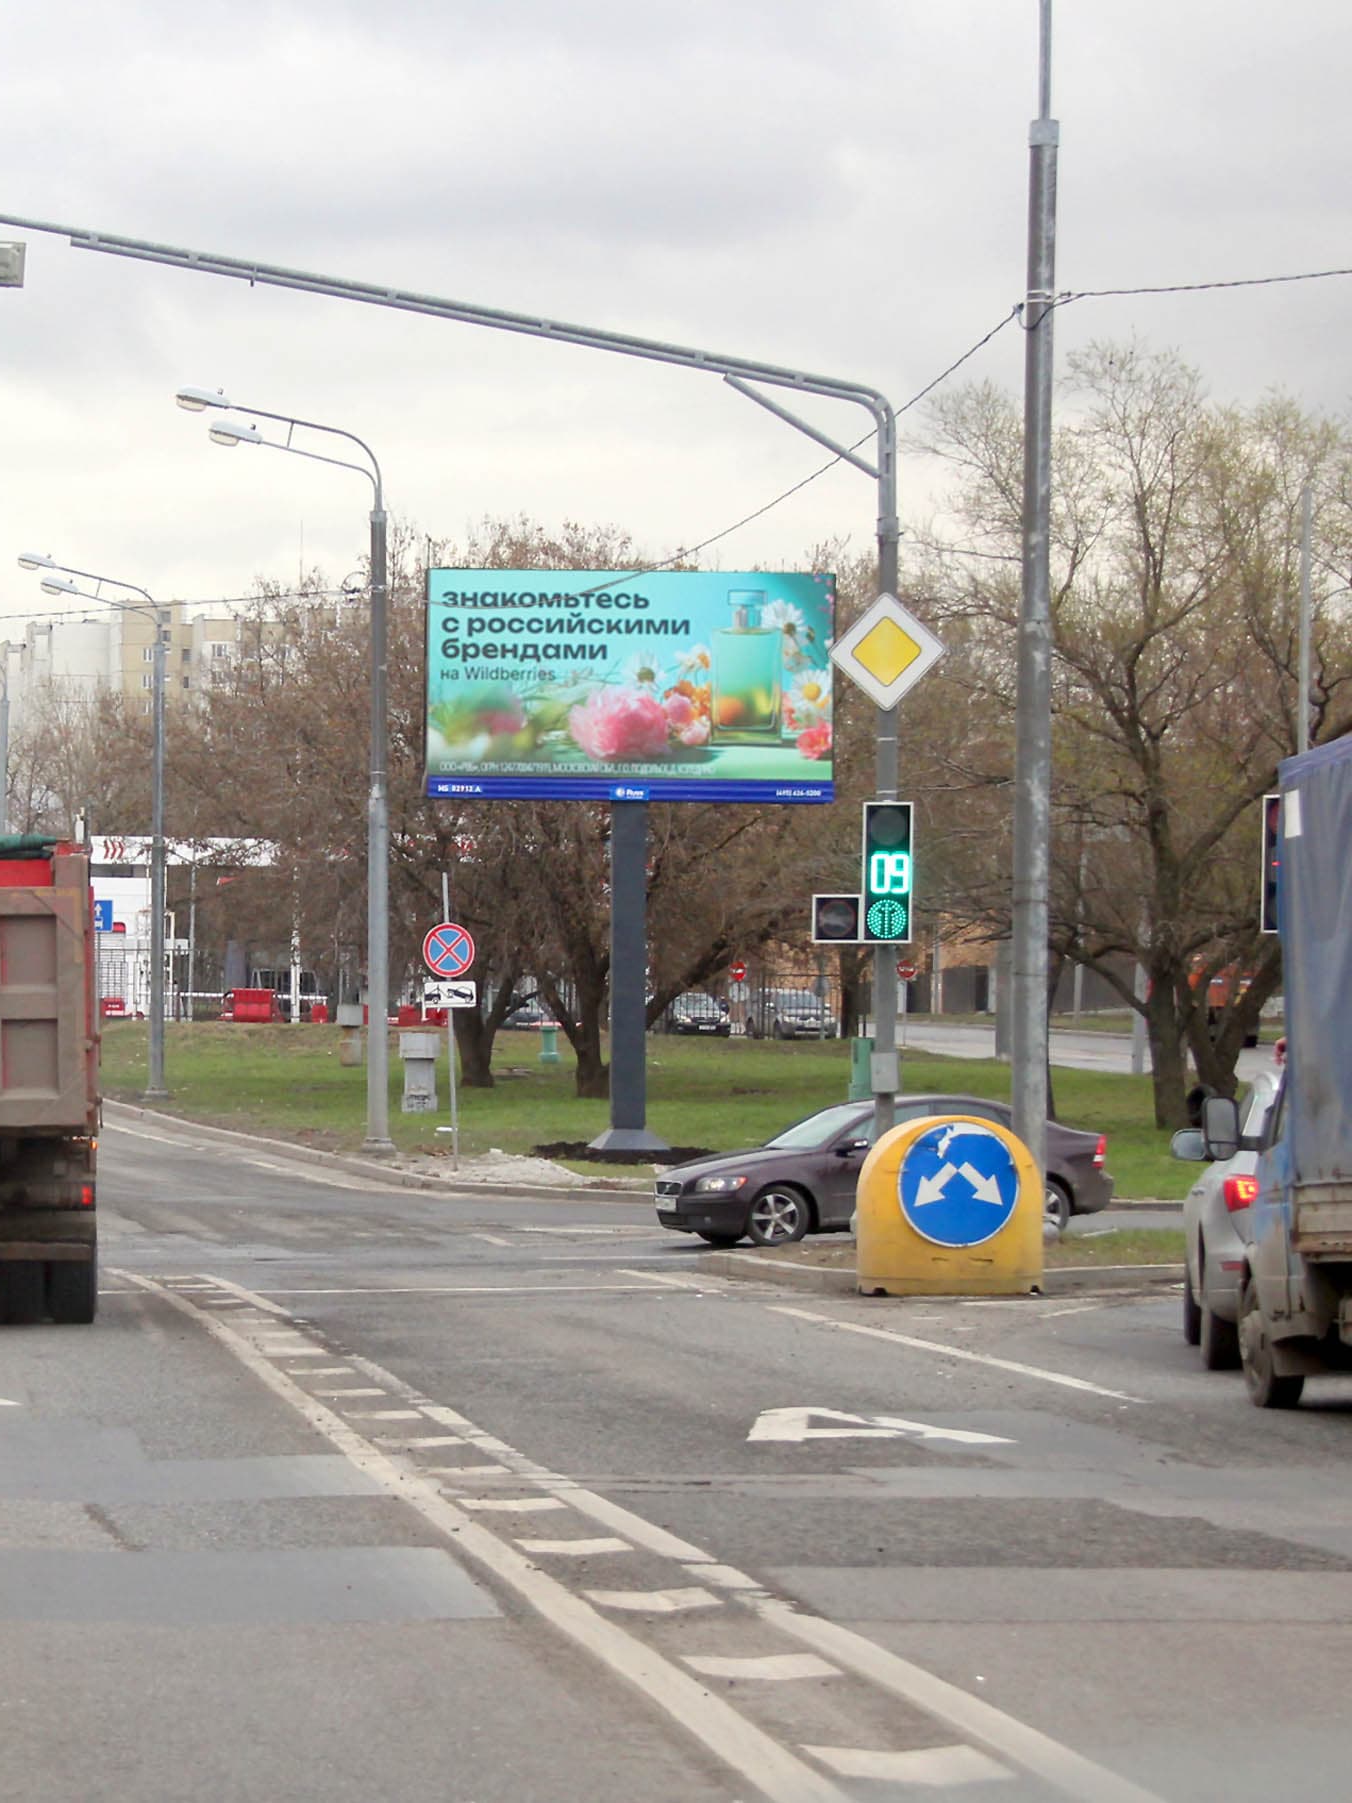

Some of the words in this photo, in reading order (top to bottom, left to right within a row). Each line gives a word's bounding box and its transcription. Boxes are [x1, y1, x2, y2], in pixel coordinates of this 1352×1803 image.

[441, 591, 649, 609] знакомьтесь
[441, 616, 460, 634] с
[467, 612, 691, 638] российскими
[441, 638, 609, 663] брендами
[440, 668, 460, 681] на
[464, 667, 557, 682] Wildberries
[871, 851, 910, 894] 09
